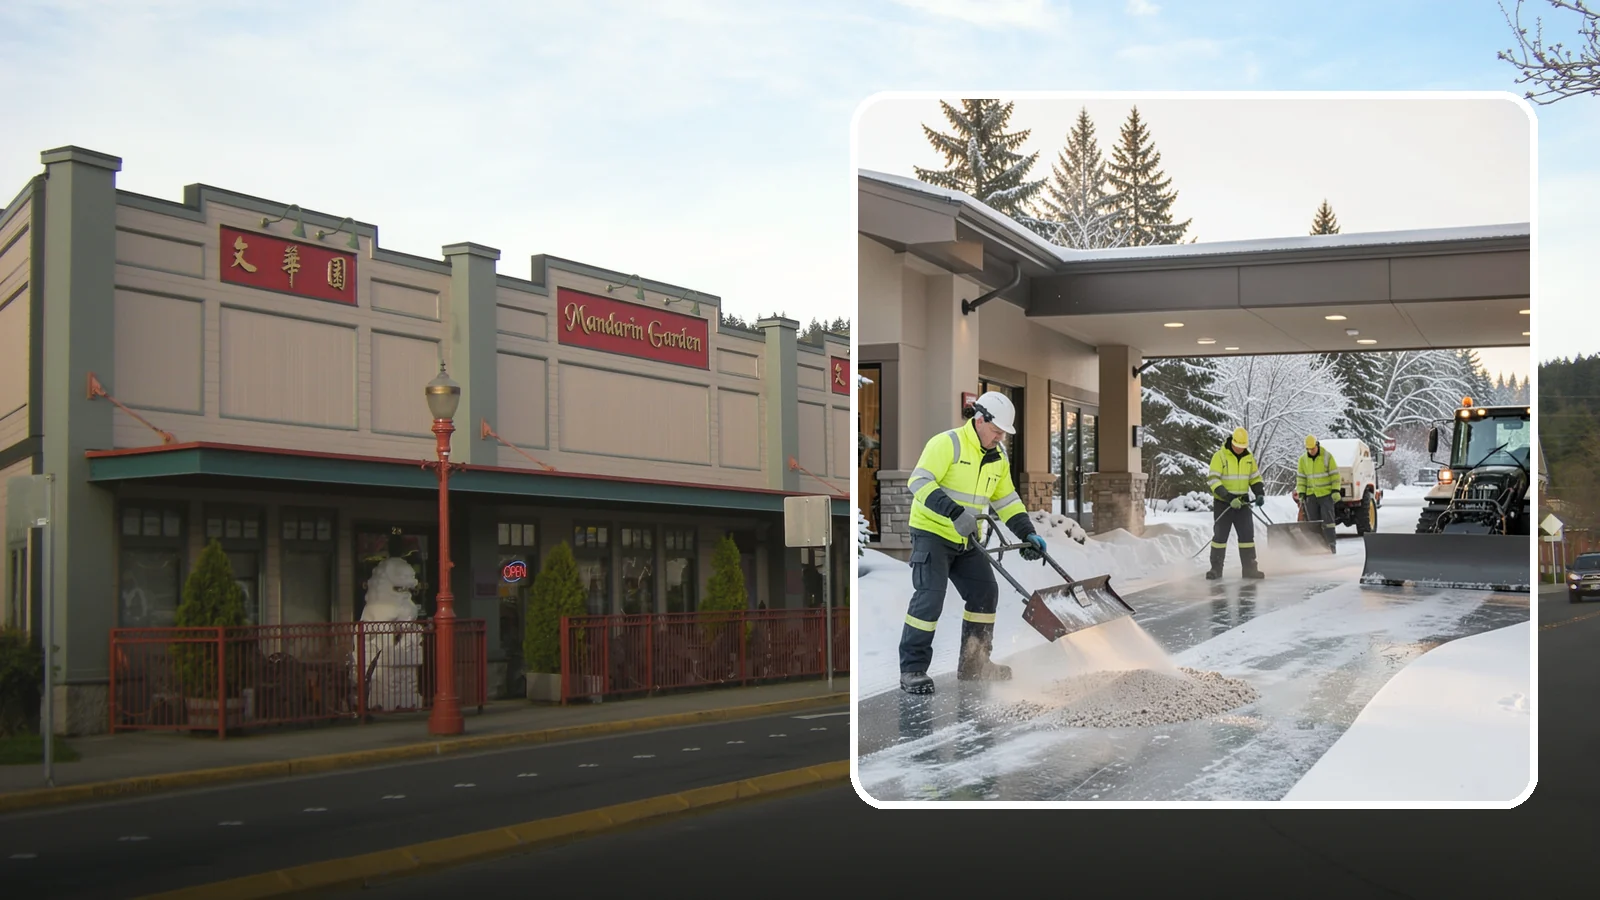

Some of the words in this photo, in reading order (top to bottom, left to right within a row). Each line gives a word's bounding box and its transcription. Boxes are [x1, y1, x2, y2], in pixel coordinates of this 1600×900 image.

[230, 235, 346, 291] 文華園
[564, 302, 644, 341] Mandarin
[648, 320, 701, 352] Garden
[503, 565, 527, 578] OPEN
